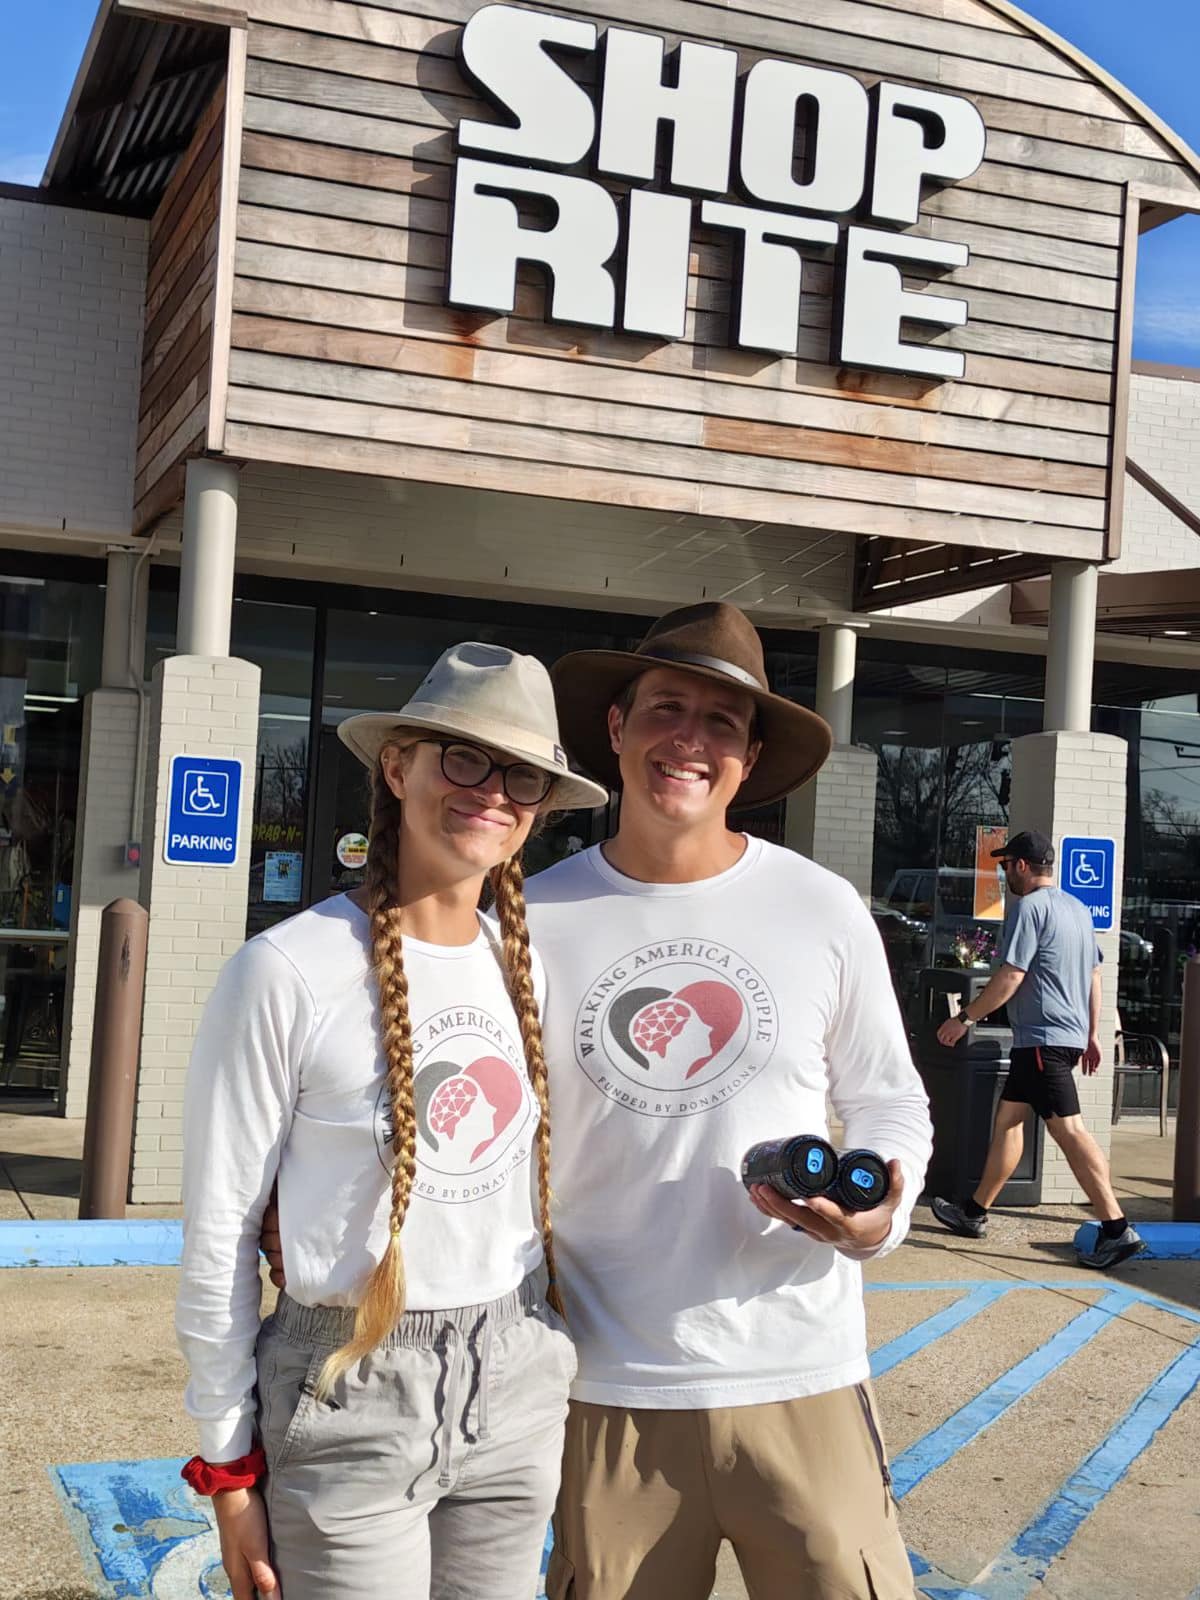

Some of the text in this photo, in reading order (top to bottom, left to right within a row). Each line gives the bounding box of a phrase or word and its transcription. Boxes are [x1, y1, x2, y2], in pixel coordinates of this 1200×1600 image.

[457, 4, 987, 225] SHOP
[448, 156, 970, 379] RITE
[171, 834, 233, 851] PARKING
[579, 942, 773, 1059] WALKING AMERICA COUPLE
[427, 1011, 503, 1043] AMERICA
[597, 1064, 757, 1113] FUNDED BY DONATIONS
[442, 1188, 457, 1199] BY
[463, 1147, 527, 1198] DONATINS
